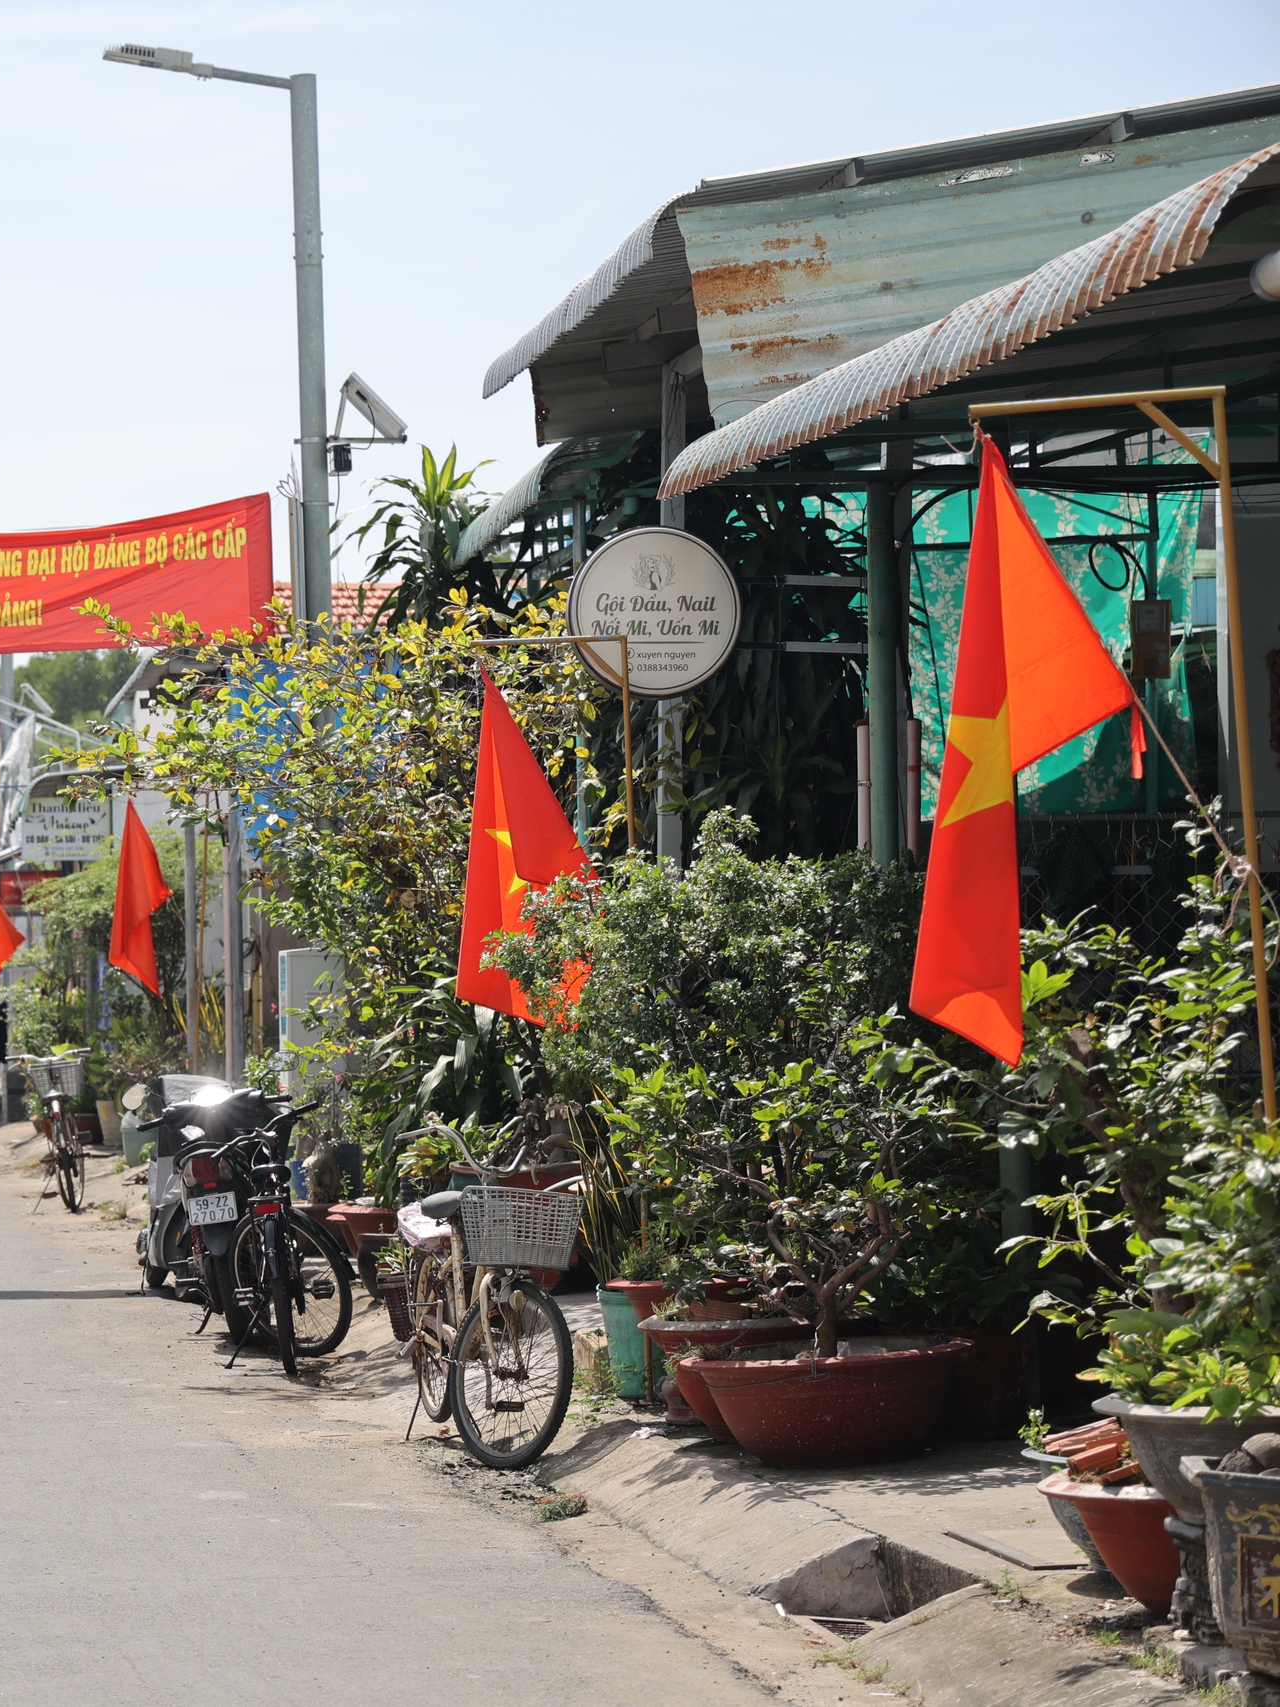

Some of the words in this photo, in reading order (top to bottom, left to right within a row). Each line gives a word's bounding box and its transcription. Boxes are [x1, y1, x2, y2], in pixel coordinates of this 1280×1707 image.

[26, 546, 56, 582] ĐẠI
[60, 540, 90, 577] HỘI
[93, 533, 141, 570] ĐẢNG
[145, 531, 169, 568] BỘ
[172, 526, 207, 560] CÁC
[212, 517, 247, 559] CẤP
[595, 592, 626, 617] Gội
[677, 595, 717, 613] Nail
[591, 617, 622, 637] Nối
[626, 620, 652, 638] Mi,
[657, 617, 693, 636] Uốn
[696, 620, 721, 637] Mi
[636, 652, 662, 660] xuyen
[664, 651, 696, 660] nguyen
[637, 664, 689, 672] 0388343960
[195, 1196, 229, 1211] 59-Z2
[193, 1207, 235, 1223] 270.70
